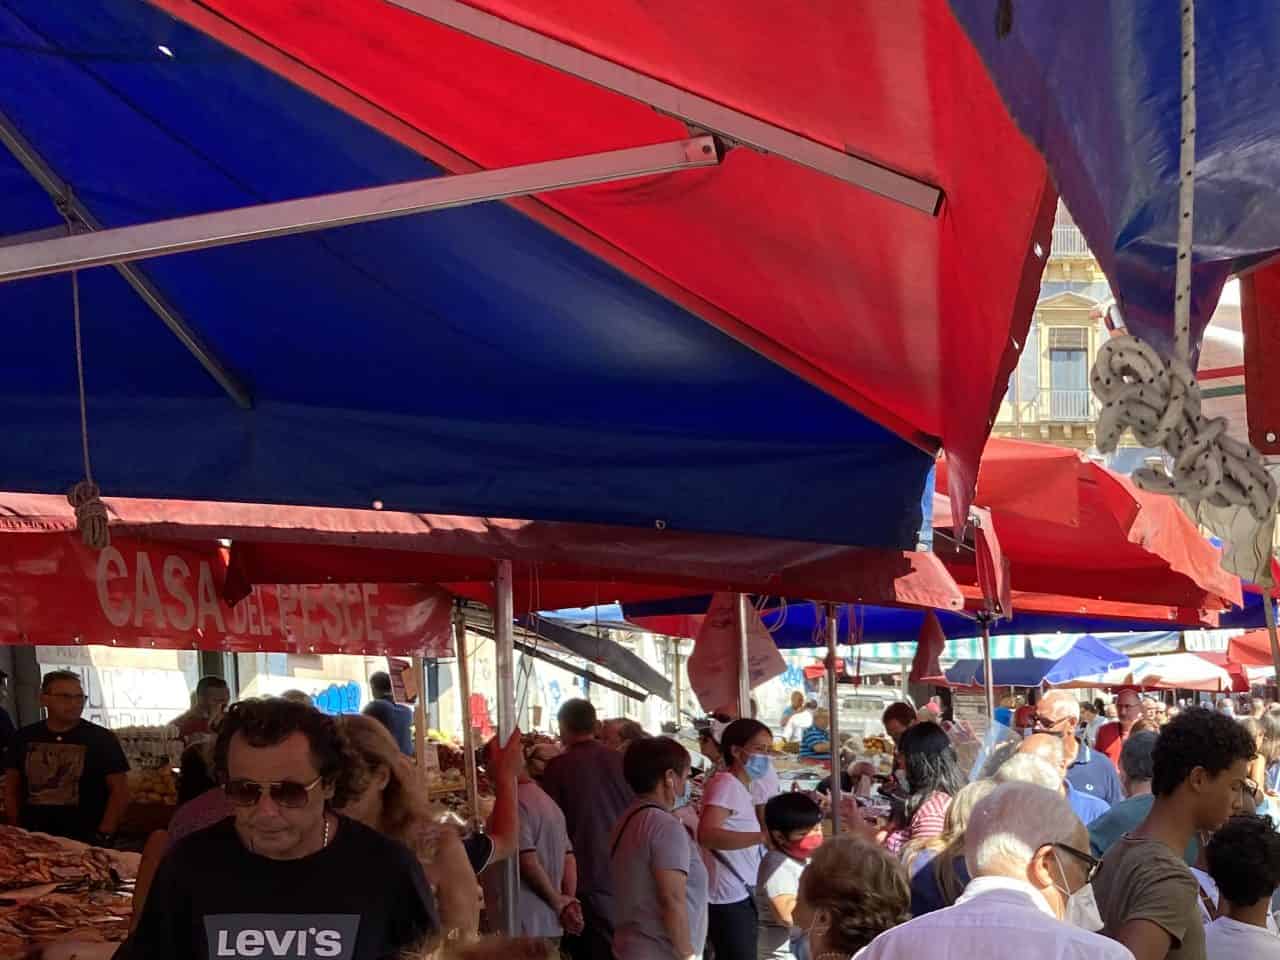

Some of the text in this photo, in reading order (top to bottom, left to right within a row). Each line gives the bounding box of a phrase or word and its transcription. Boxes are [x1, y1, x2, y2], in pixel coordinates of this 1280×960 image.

[96, 546, 383, 642] CASA DEL PESCE
